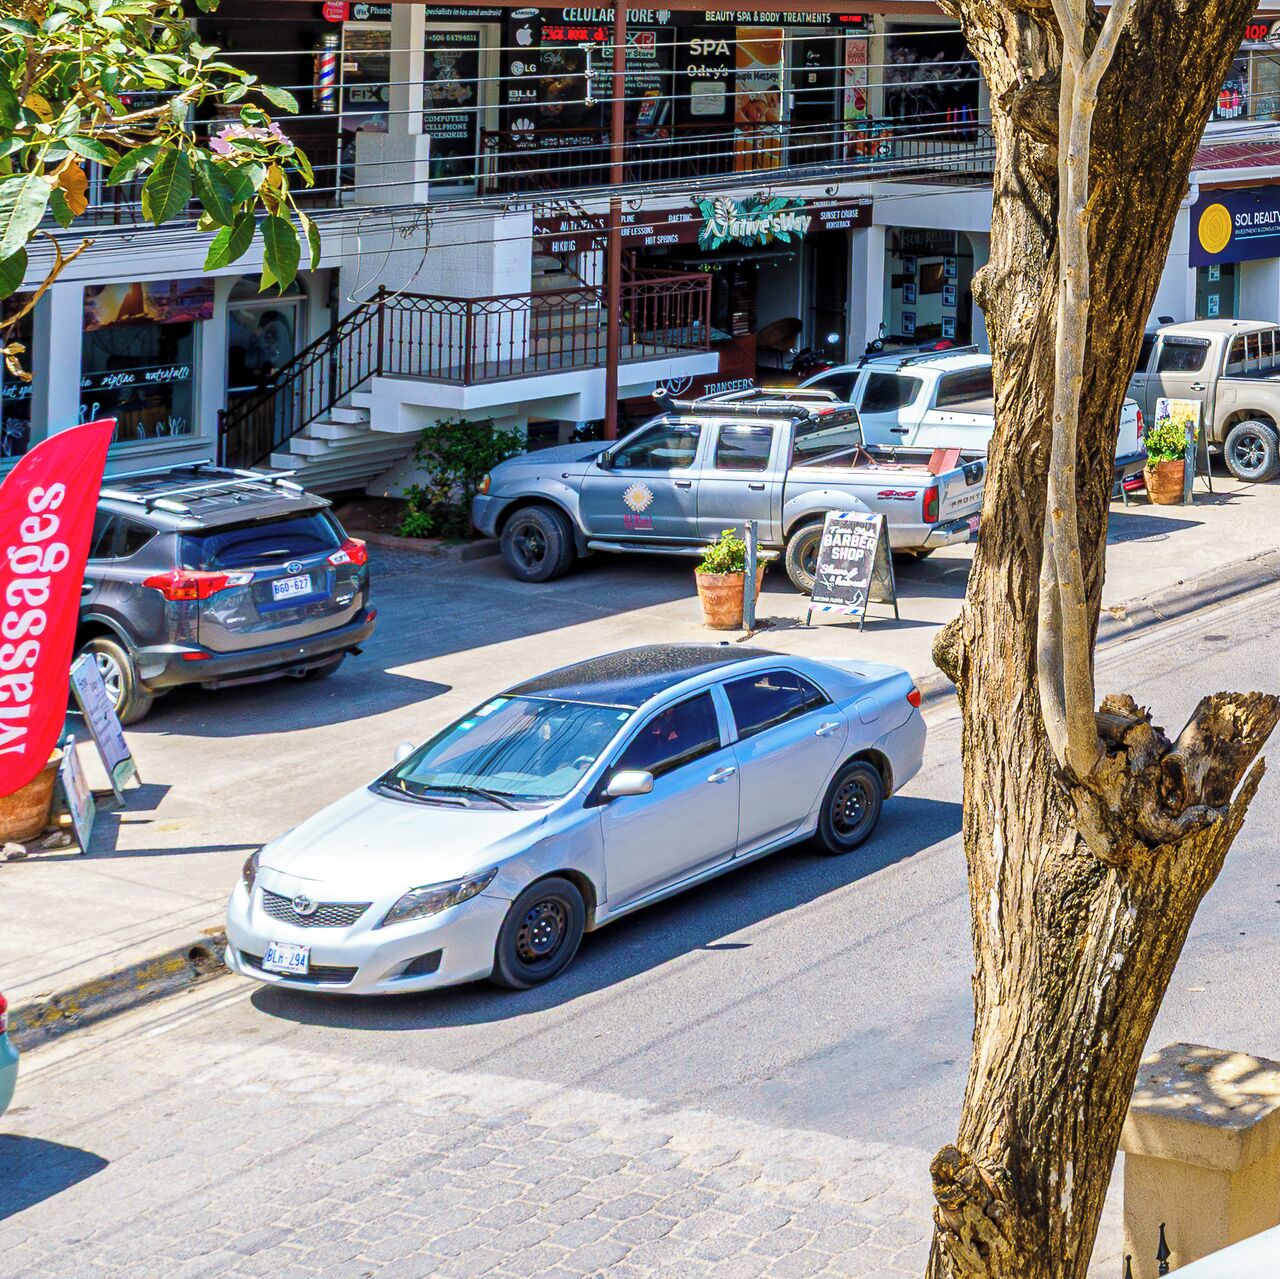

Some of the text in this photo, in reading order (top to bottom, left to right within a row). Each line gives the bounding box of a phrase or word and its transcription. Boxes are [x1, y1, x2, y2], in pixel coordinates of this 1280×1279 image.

[424, 7, 451, 16] pecialists
[480, 8, 502, 16] android
[562, 8, 653, 22] CELULAR TORE
[705, 11, 831, 23] BEAUTY SPA & BODY TREATMENTS
[1244, 25, 1268, 39] HOP
[689, 39, 731, 55] SPA
[687, 64, 728, 79] Odry's
[429, 131, 468, 139] CCESORIES
[820, 209, 859, 220] SUNSET CRUISE
[1235, 213, 1252, 226] SOL
[632, 226, 654, 235] LESSONS
[1234, 227, 1258, 235] INVESTMENT
[645, 234, 679, 245] HOT SPRINGS
[552, 240, 577, 252] HIKING
[823, 533, 876, 550] BARBER
[831, 546, 865, 561] SHOP
